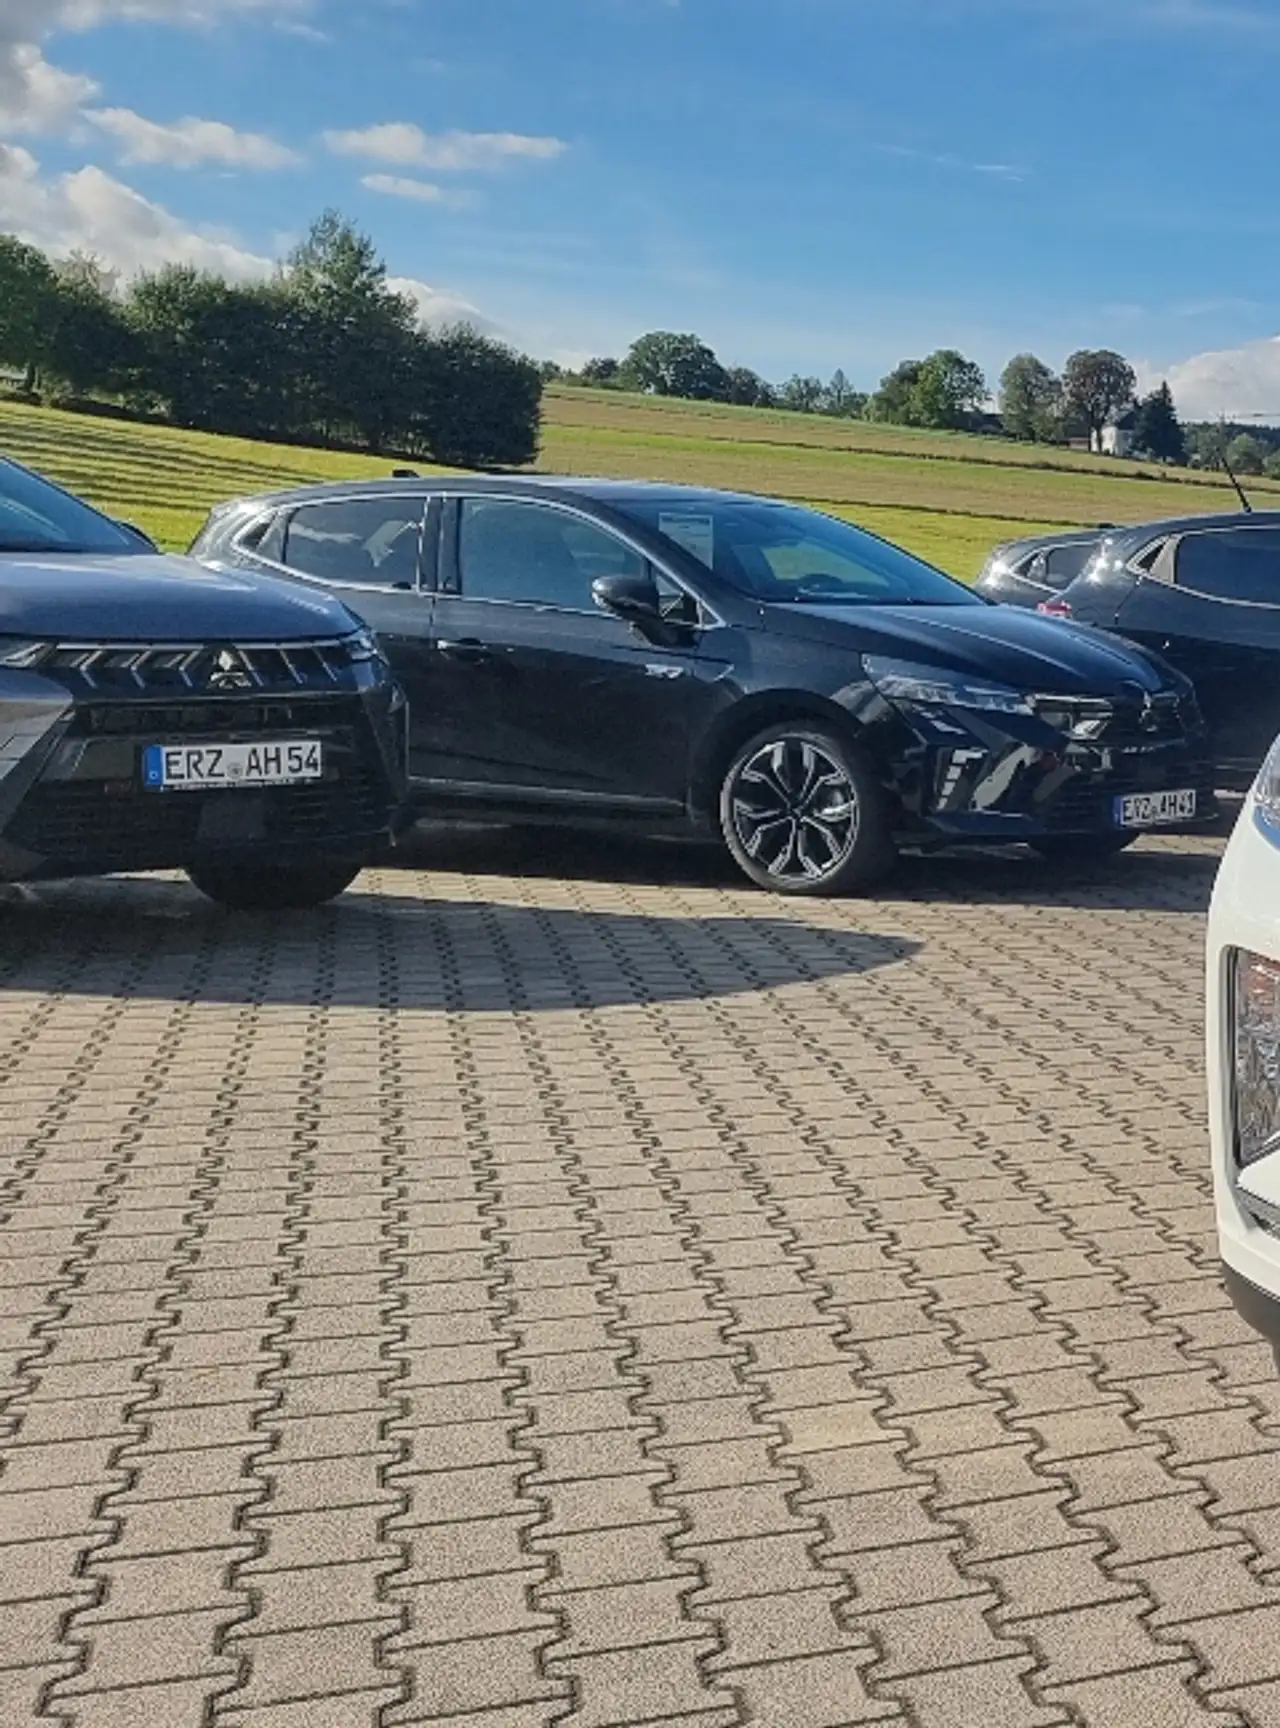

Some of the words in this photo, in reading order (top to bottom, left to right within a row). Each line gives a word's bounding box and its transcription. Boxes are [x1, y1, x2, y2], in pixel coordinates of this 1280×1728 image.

[165, 749, 226, 780] ERZ
[245, 746, 282, 777] AH
[287, 745, 320, 774] 54
